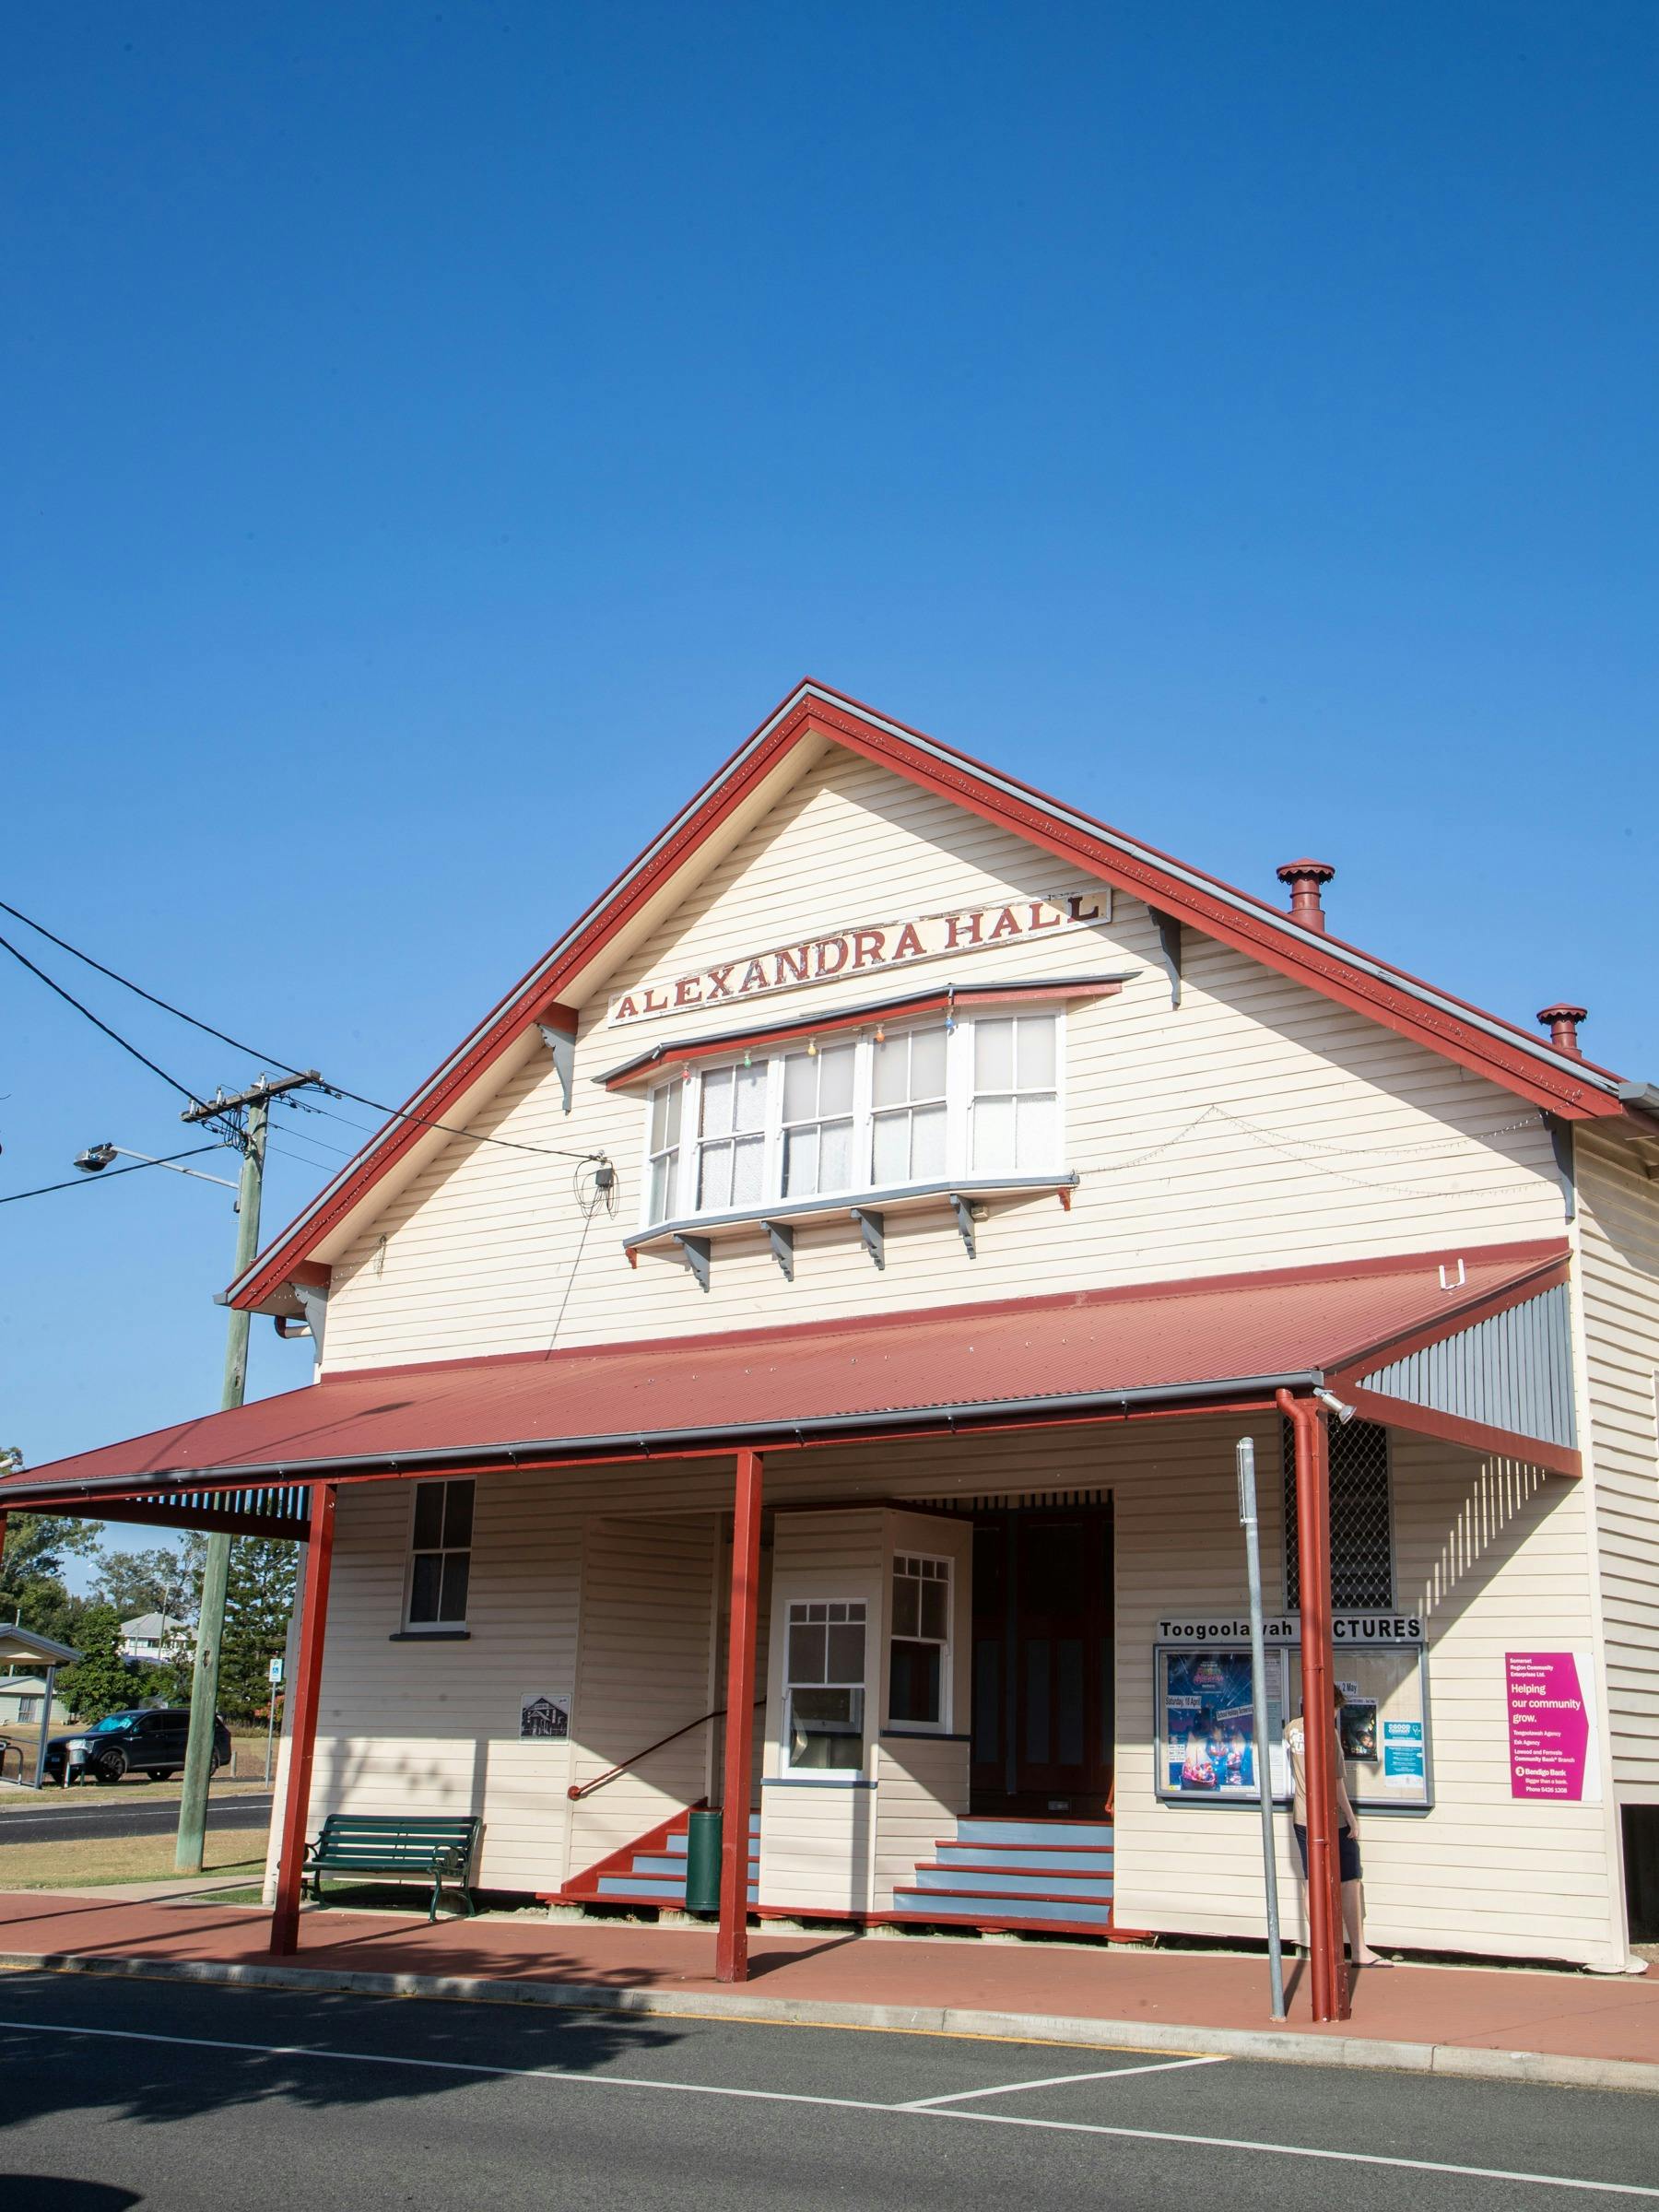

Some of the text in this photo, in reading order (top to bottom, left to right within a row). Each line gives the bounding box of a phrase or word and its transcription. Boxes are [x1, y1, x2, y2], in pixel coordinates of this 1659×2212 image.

[616, 897, 1100, 1020] ALEXANDRA HALL
[1334, 1619, 1420, 1638] CTURES
[1342, 1683, 1358, 1694] 2 May
[1512, 1684, 1547, 1696] Helping
[1528, 1699, 1581, 1711] community
[1512, 1713, 1537, 1724] grow.
[1524, 1768, 1566, 1777] Bendigo Bank
